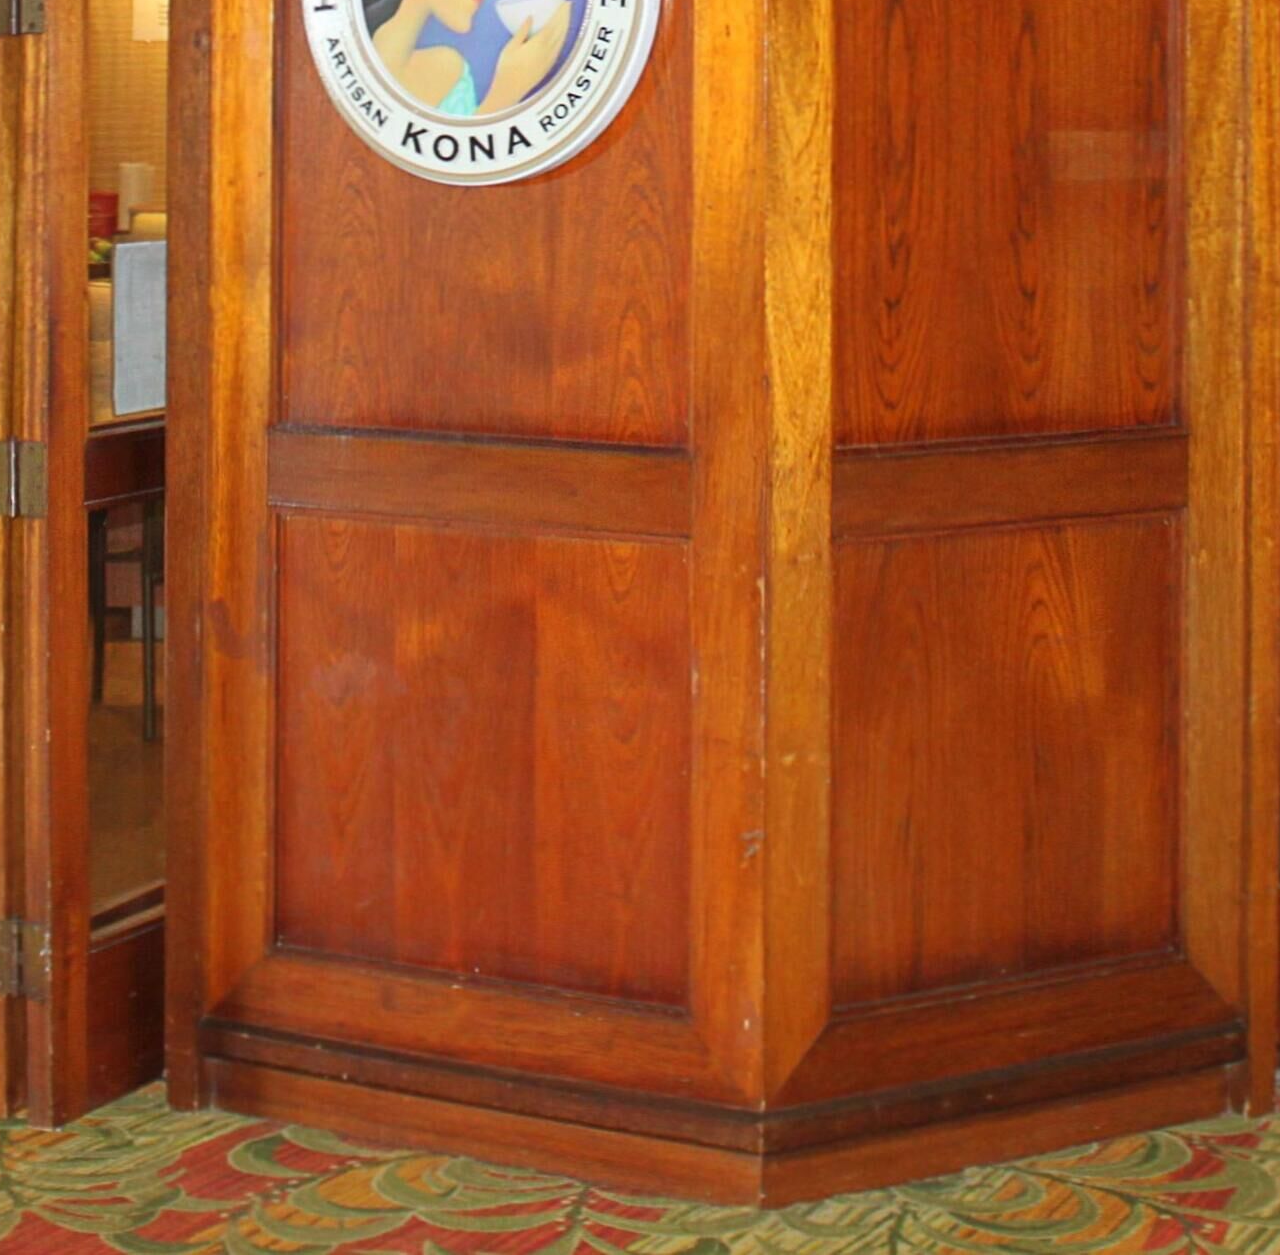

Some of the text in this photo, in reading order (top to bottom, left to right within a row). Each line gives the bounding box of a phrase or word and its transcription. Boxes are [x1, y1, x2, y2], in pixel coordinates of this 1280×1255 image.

[325, 25, 615, 163] ARTISAN KONA ROASTER
